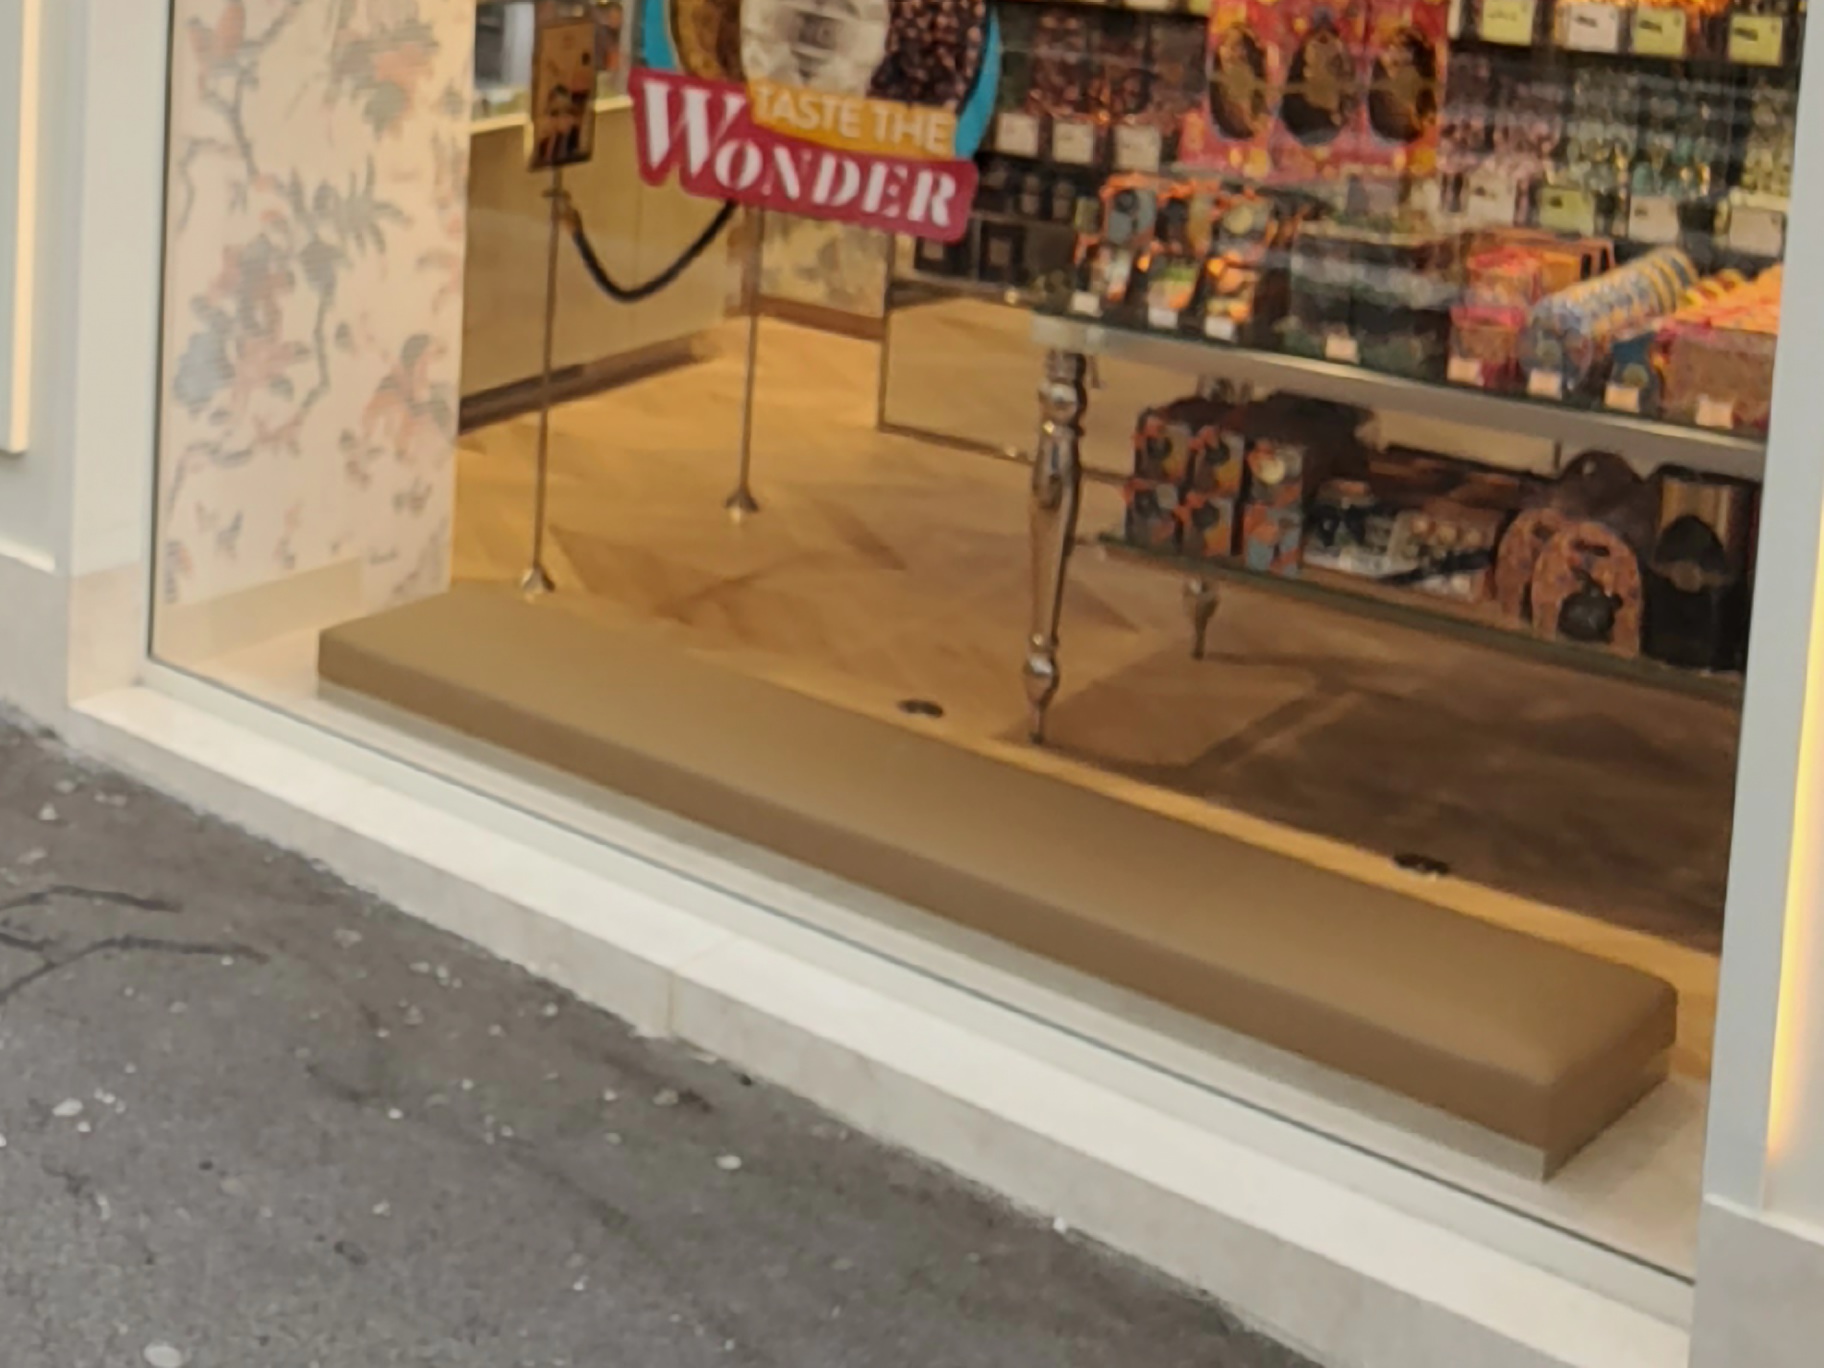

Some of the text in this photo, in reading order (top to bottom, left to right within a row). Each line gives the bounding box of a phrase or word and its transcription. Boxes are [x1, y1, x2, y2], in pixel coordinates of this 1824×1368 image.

[643, 79, 956, 227] WONDER
[755, 85, 946, 154] TASTE THE
